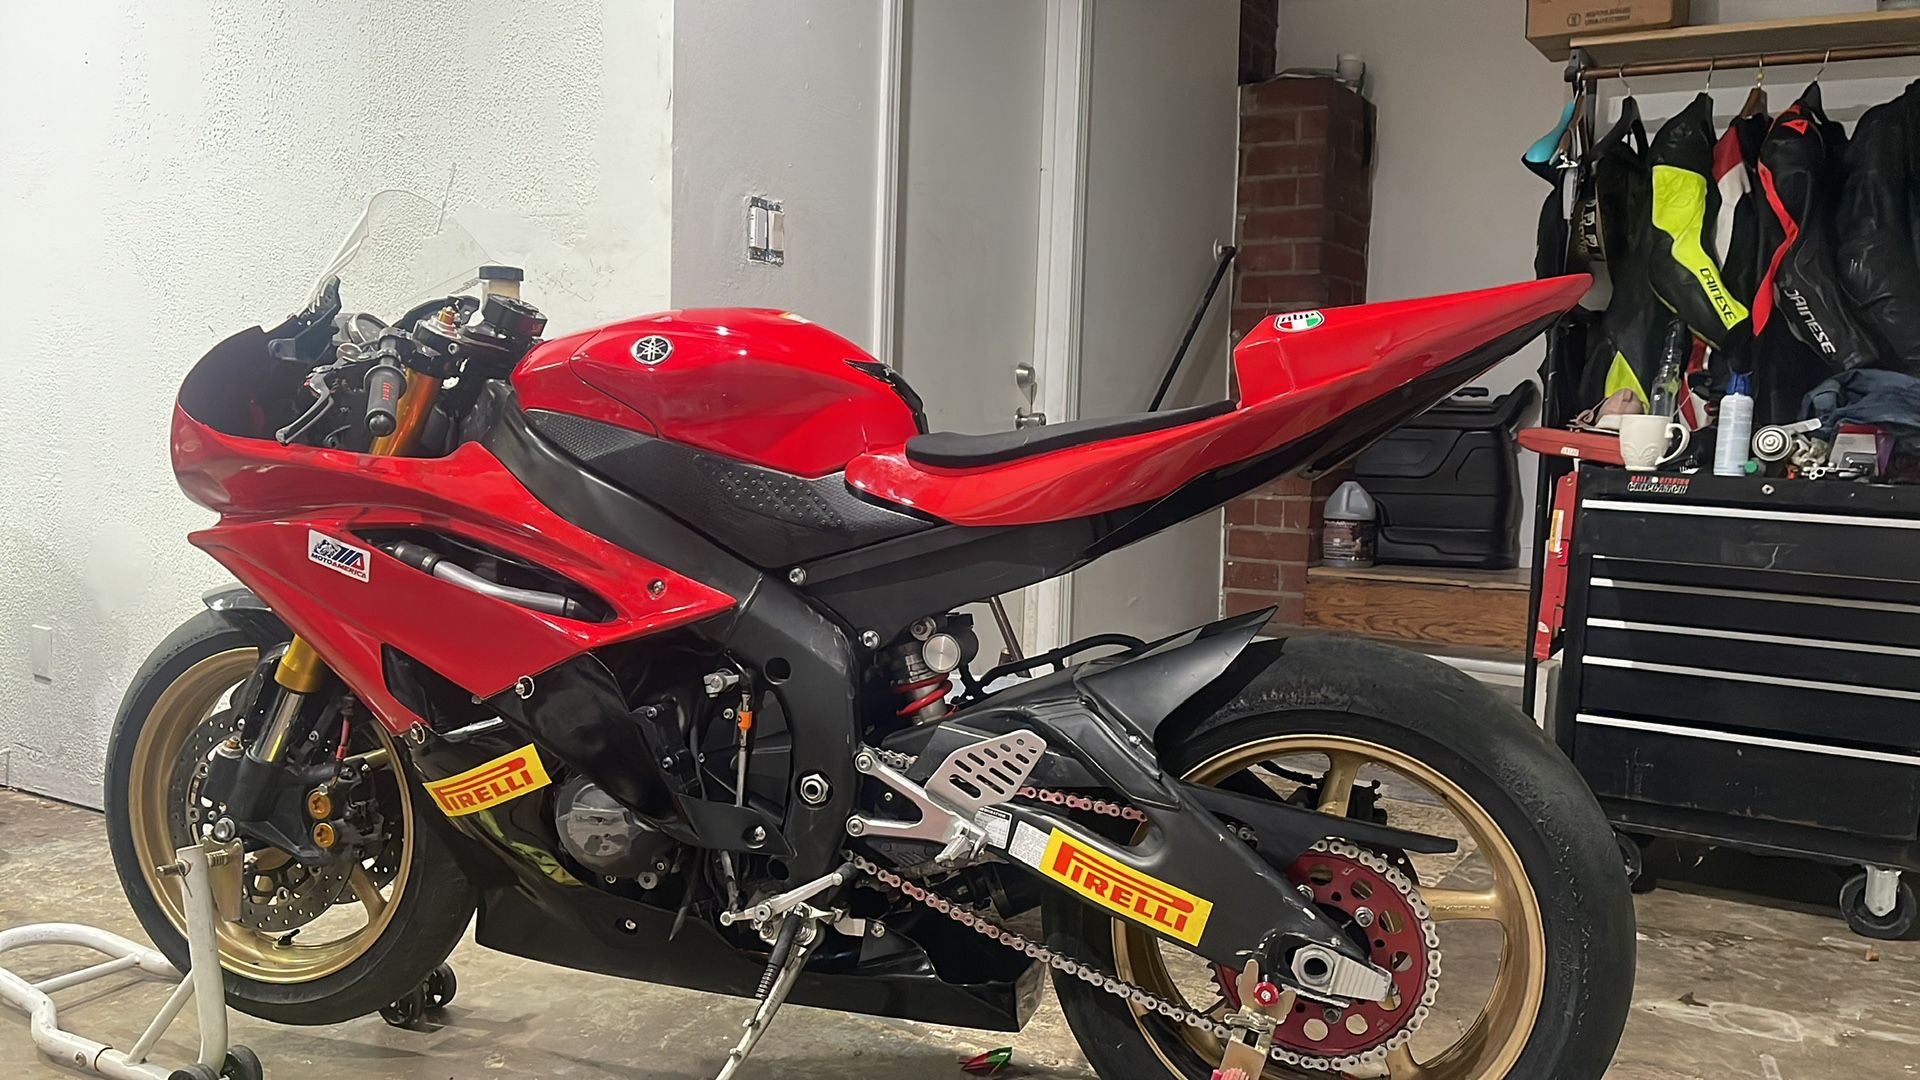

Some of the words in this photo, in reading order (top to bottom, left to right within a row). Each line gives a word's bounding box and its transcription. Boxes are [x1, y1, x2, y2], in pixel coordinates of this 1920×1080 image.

[1700, 268, 1737, 321] DAINESE
[311, 553, 367, 579] MOTOAMERICA
[432, 757, 534, 811] PIRELLI
[1053, 841, 1195, 932] PIRELLI
